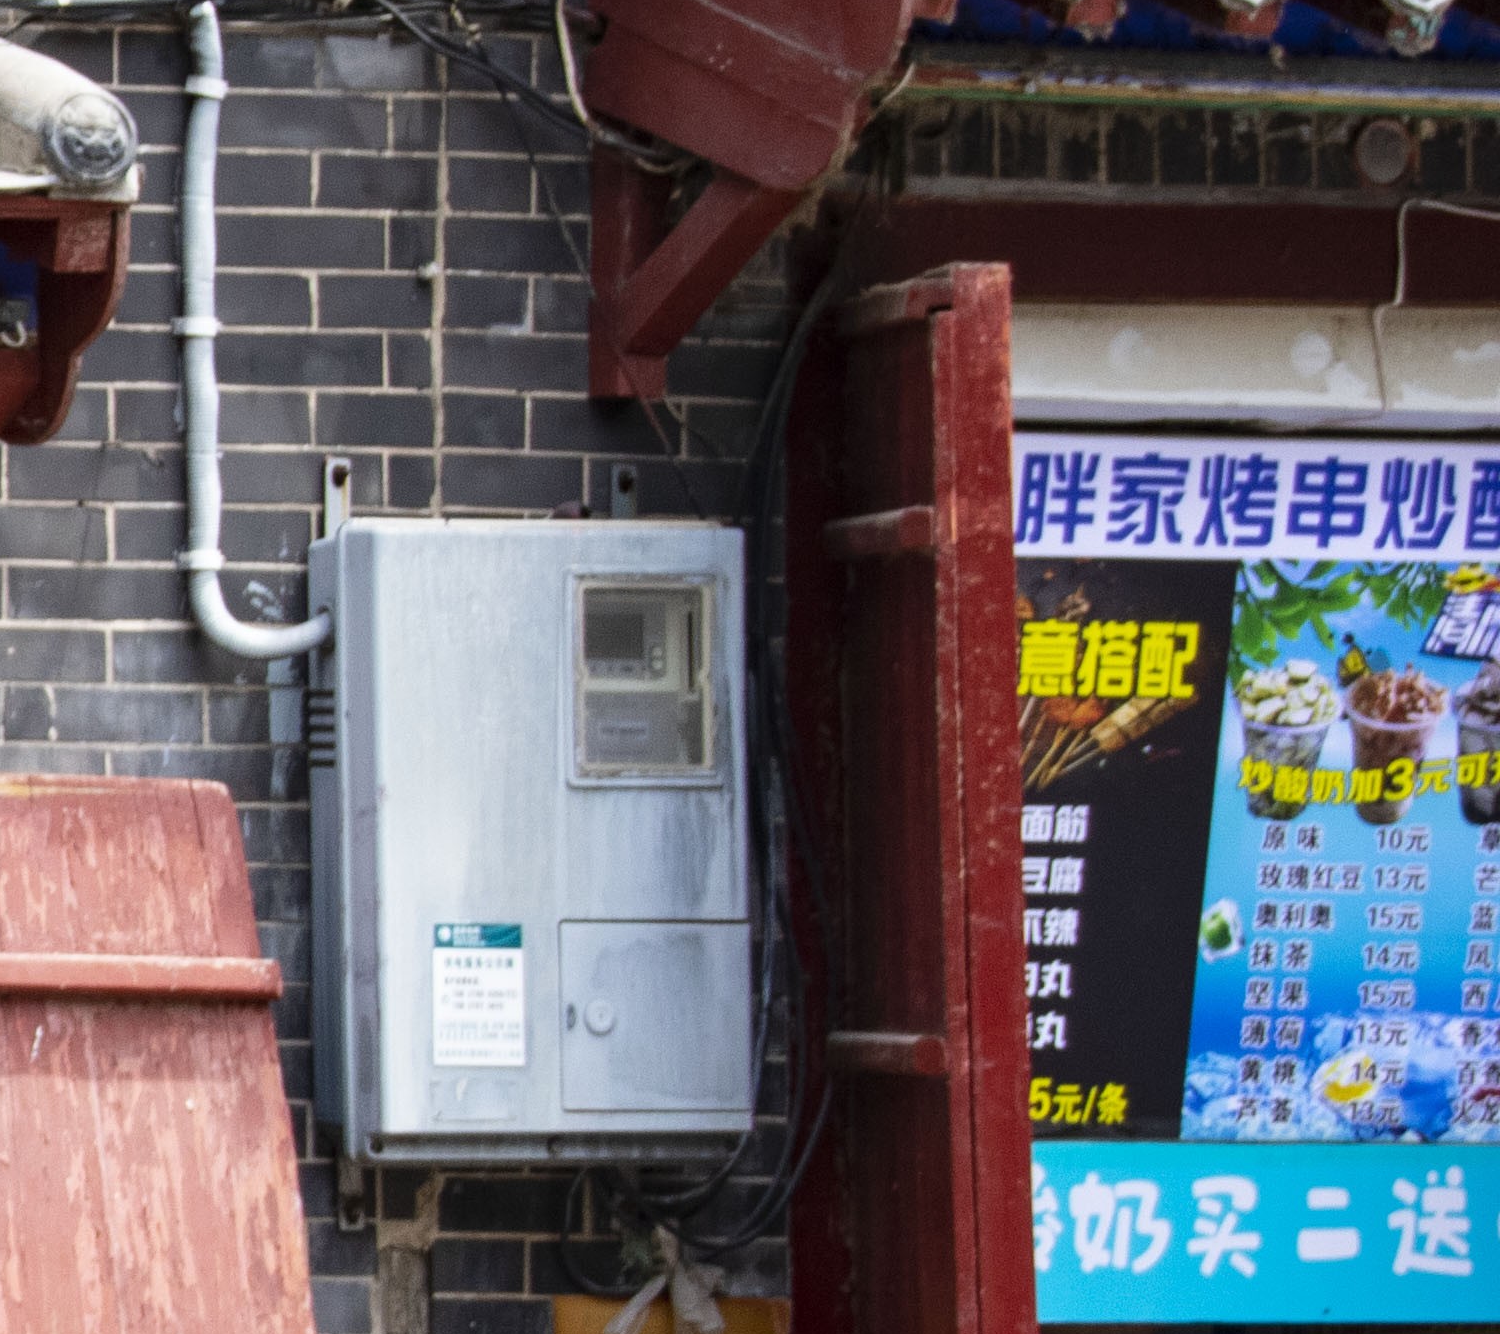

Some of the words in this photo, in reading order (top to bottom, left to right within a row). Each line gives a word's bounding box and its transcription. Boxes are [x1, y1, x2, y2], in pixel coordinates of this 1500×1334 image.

[1017, 619, 1200, 699] 意搭配
[1021, 804, 1091, 843] 面筋
[1262, 823, 1321, 851] 原味
[1377, 826, 1429, 852] 10元
[1258, 864, 1363, 891] 玫瑰红豆
[1374, 866, 1426, 892] 13元
[1255, 901, 1333, 930] 奥利奥
[1368, 903, 1421, 931] 15元
[1251, 940, 1310, 969] 抹茶
[1363, 943, 1419, 970] 14元
[1245, 978, 1307, 1008] 坚果
[1359, 981, 1414, 1009] 15元
[1462, 980, 1500, 1010] 西
[1242, 1016, 1303, 1047] 薄荷
[1356, 1020, 1408, 1046] 13元
[1461, 1020, 1500, 1047] 香
[1240, 1055, 1297, 1085] 黄桃
[1352, 1059, 1404, 1085] 14元
[1237, 1097, 1292, 1123] 芦荟
[1350, 1099, 1401, 1124] 13元
